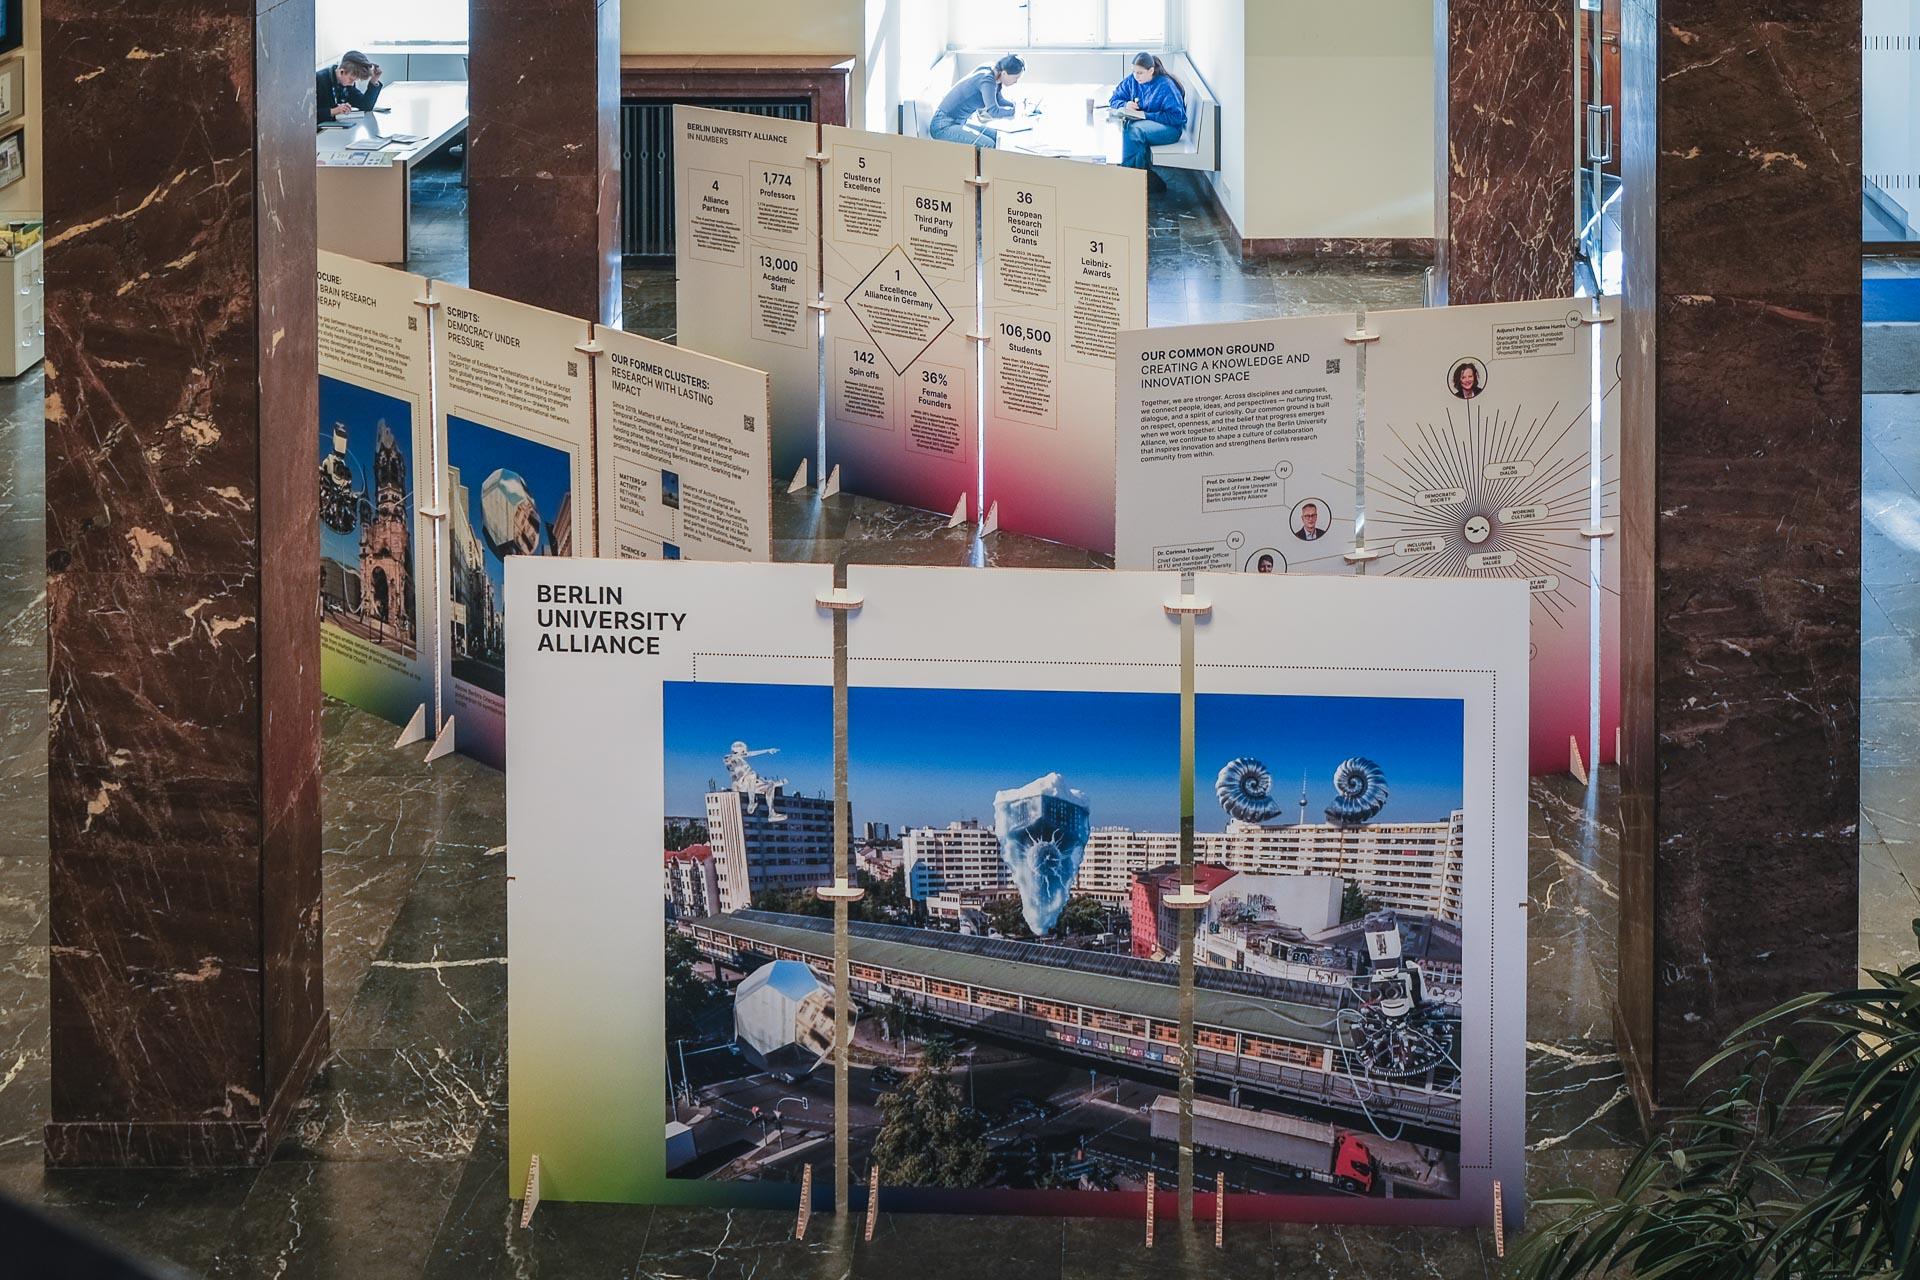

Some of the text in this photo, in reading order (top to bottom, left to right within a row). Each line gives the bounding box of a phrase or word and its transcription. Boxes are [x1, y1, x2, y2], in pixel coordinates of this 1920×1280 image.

[687, 123, 787, 143] BERLIN UNIVERSITY ALLIANCE
[695, 134, 728, 144] NUMBERS
[858, 157, 866, 169] 5
[763, 171, 792, 186] 1,774
[843, 172, 872, 183] Clusters
[712, 181, 719, 191] 4
[844, 181, 881, 194] Excellence
[703, 195, 729, 205] Alliance
[760, 189, 796, 201] Professors
[1017, 191, 1033, 204] 36
[702, 204, 730, 214] Partners
[1008, 208, 1042, 220] European
[914, 214, 953, 228] Third Party
[1008, 217, 1042, 228] Research
[920, 225, 948, 237] Funding
[1011, 226, 1039, 237] Council
[1013, 235, 1037, 246] Grants
[1090, 241, 1104, 254] 31
[760, 256, 798, 272] 13,000
[1081, 257, 1112, 269] Leibniz-
[763, 273, 795, 285] Academic
[895, 270, 900, 281] 1
[1083, 268, 1111, 279] Awards
[771, 283, 787, 292] Staff
[880, 284, 917, 298] Excellence
[320, 284, 377, 307] BRAIN RESEARCH
[865, 290, 933, 310] Alliance in Germany
[318, 297, 341, 309] ERAPY
[447, 307, 480, 322] SCRIPTS:
[448, 319, 521, 348] DEMOCRACY UNDER
[1000, 323, 1051, 343] 106,500
[448, 333, 484, 351] PRESSURE
[1009, 343, 1042, 356] Students
[1141, 342, 1274, 361] OUR COMMON GROUND
[854, 350, 875, 365] 142
[1141, 353, 1309, 374] CREATING A KNOWLEDGE AND
[612, 353, 710, 389] OUR FORMER CLUSTERS:
[849, 367, 879, 379] Spin offs
[922, 370, 948, 386] 36%
[612, 366, 713, 406] RESEARCH WITH LASTING
[1141, 371, 1249, 388] INNOVATION SPACE
[612, 380, 641, 397] IMPACT
[922, 388, 947, 399] Female
[918, 396, 951, 409] Founders
[1140, 398, 1170, 408] Together,
[1194, 394, 1222, 404] stronger.
[1224, 392, 1245, 400] Across
[1247, 389, 1279, 400] disciplines
[1294, 387, 1327, 396] campuses,
[1151, 405, 1177, 413] connect
[1178, 403, 1202, 413] people,
[1203, 402, 1222, 410] ideas,
[1236, 397, 1276, 408] perspectives
[1286, 394, 1314, 404] nurturing
[1316, 393, 1332, 401] trust,
[1140, 414, 1169, 424] dialogue,
[1190, 411, 1206, 420] spirit
[1215, 408, 1243, 418] curiosity.
[1287, 403, 1308, 412] ground
[1150, 421, 1176, 431] respect,
[1177, 420, 1210, 429] openness,
[1269, 413, 1296, 421] progress
[1298, 410, 1324, 419] emerges
[1187, 426, 1215, 436] together.
[1217, 424, 1237, 432] United
[1239, 422, 1263, 432] through
[1295, 417, 1326, 427] University
[1140, 438, 1167, 446] Alliance,
[1216, 432, 1235, 441] shape
[1273, 426, 1313, 435] collaboration
[1155, 445, 1179, 454] inspires
[1181, 442, 1213, 450] innovation
[1228, 438, 1265, 448] strengthens
[1290, 433, 1317, 441] research
[1140, 453, 1175, 464] community
[1177, 451, 1192, 459] from
[537, 584, 622, 605] BERLIN
[537, 609, 687, 632] UNIVERSITY
[537, 633, 660, 655] ALLIANCE
